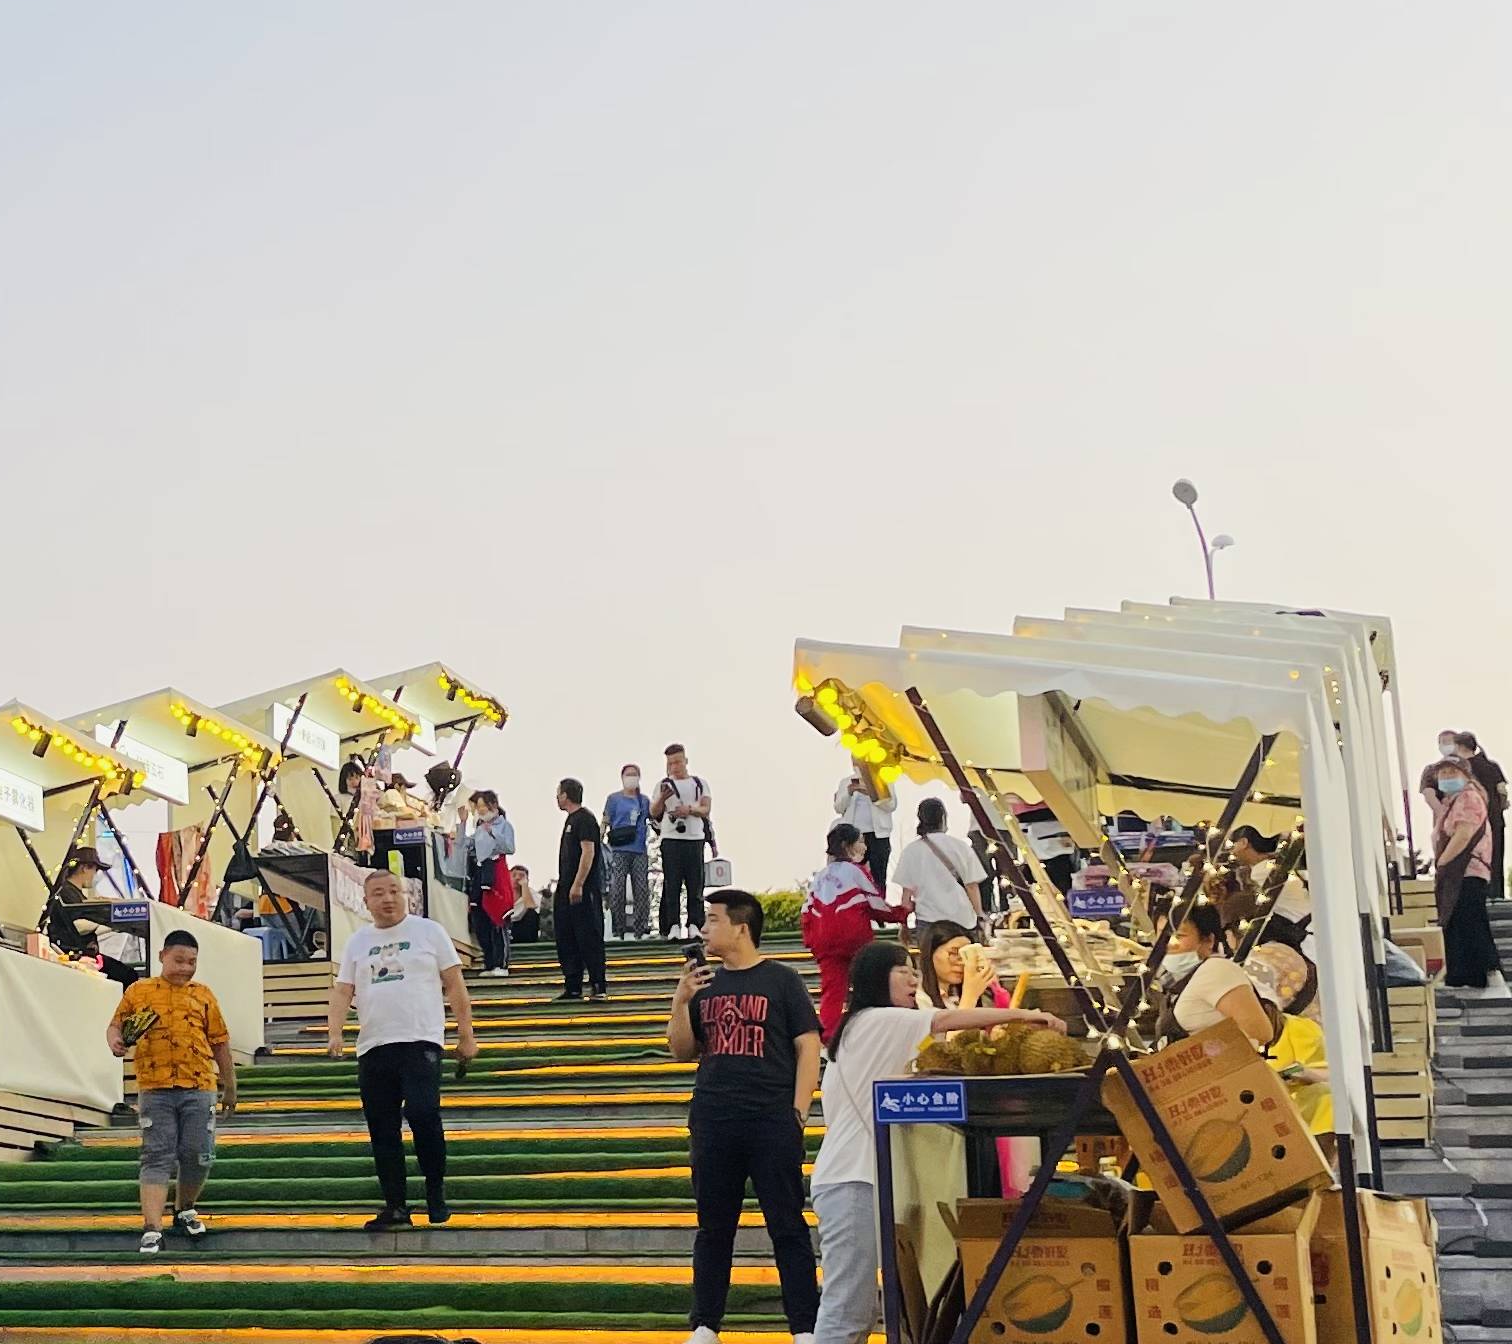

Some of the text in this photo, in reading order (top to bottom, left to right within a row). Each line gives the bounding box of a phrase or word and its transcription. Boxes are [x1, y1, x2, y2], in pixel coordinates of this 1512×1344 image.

[739, 994, 768, 1023] AND
[902, 1092, 959, 1105] 小心台阶
